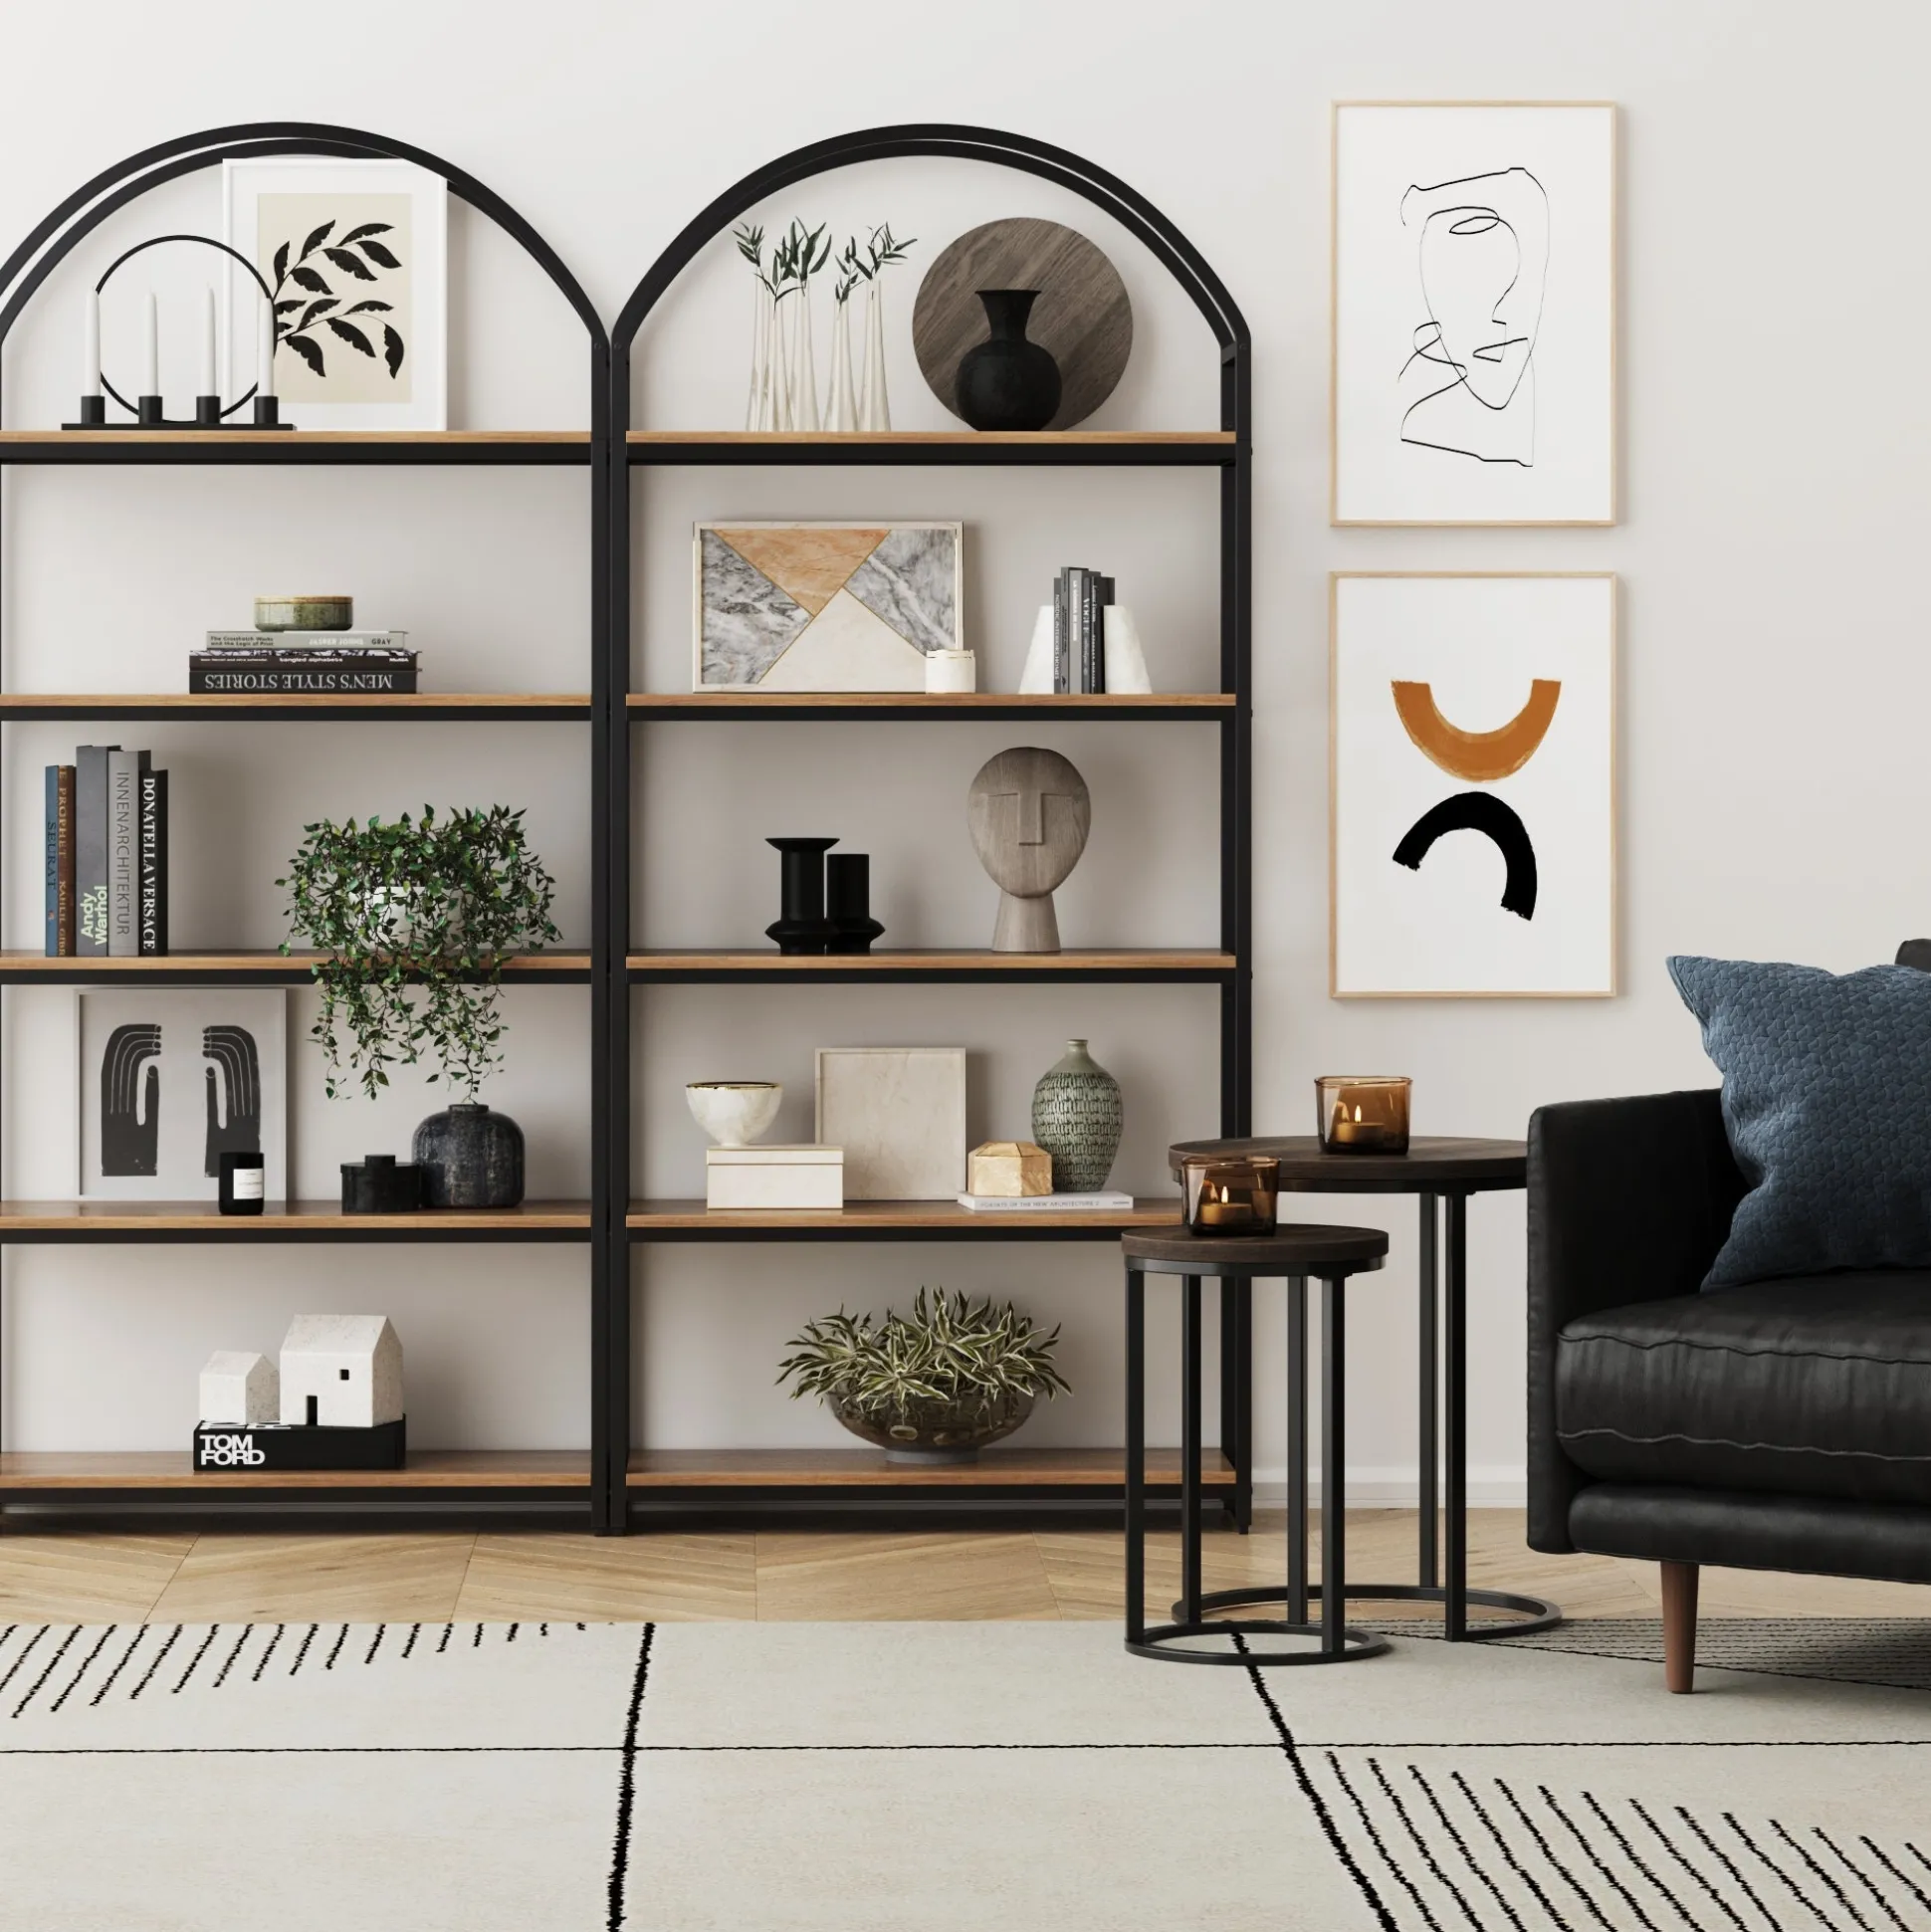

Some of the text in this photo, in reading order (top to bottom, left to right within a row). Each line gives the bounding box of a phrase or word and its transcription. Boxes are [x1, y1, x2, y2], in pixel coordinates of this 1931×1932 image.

[371, 637, 391, 646] GRAY
[204, 674, 393, 690] MEN'S STYLE STORIES
[58, 787, 68, 860] PROPHET
[47, 821, 57, 891] SEURAT
[115, 771, 130, 936] INNENARCHITEKTUR
[142, 777, 156, 950] DONATELLA VERSACE
[80, 893, 95, 938] Andy
[94, 885, 107, 946] Warhol
[199, 1434, 253, 1451] TOM
[200, 1449, 266, 1465] FORD
